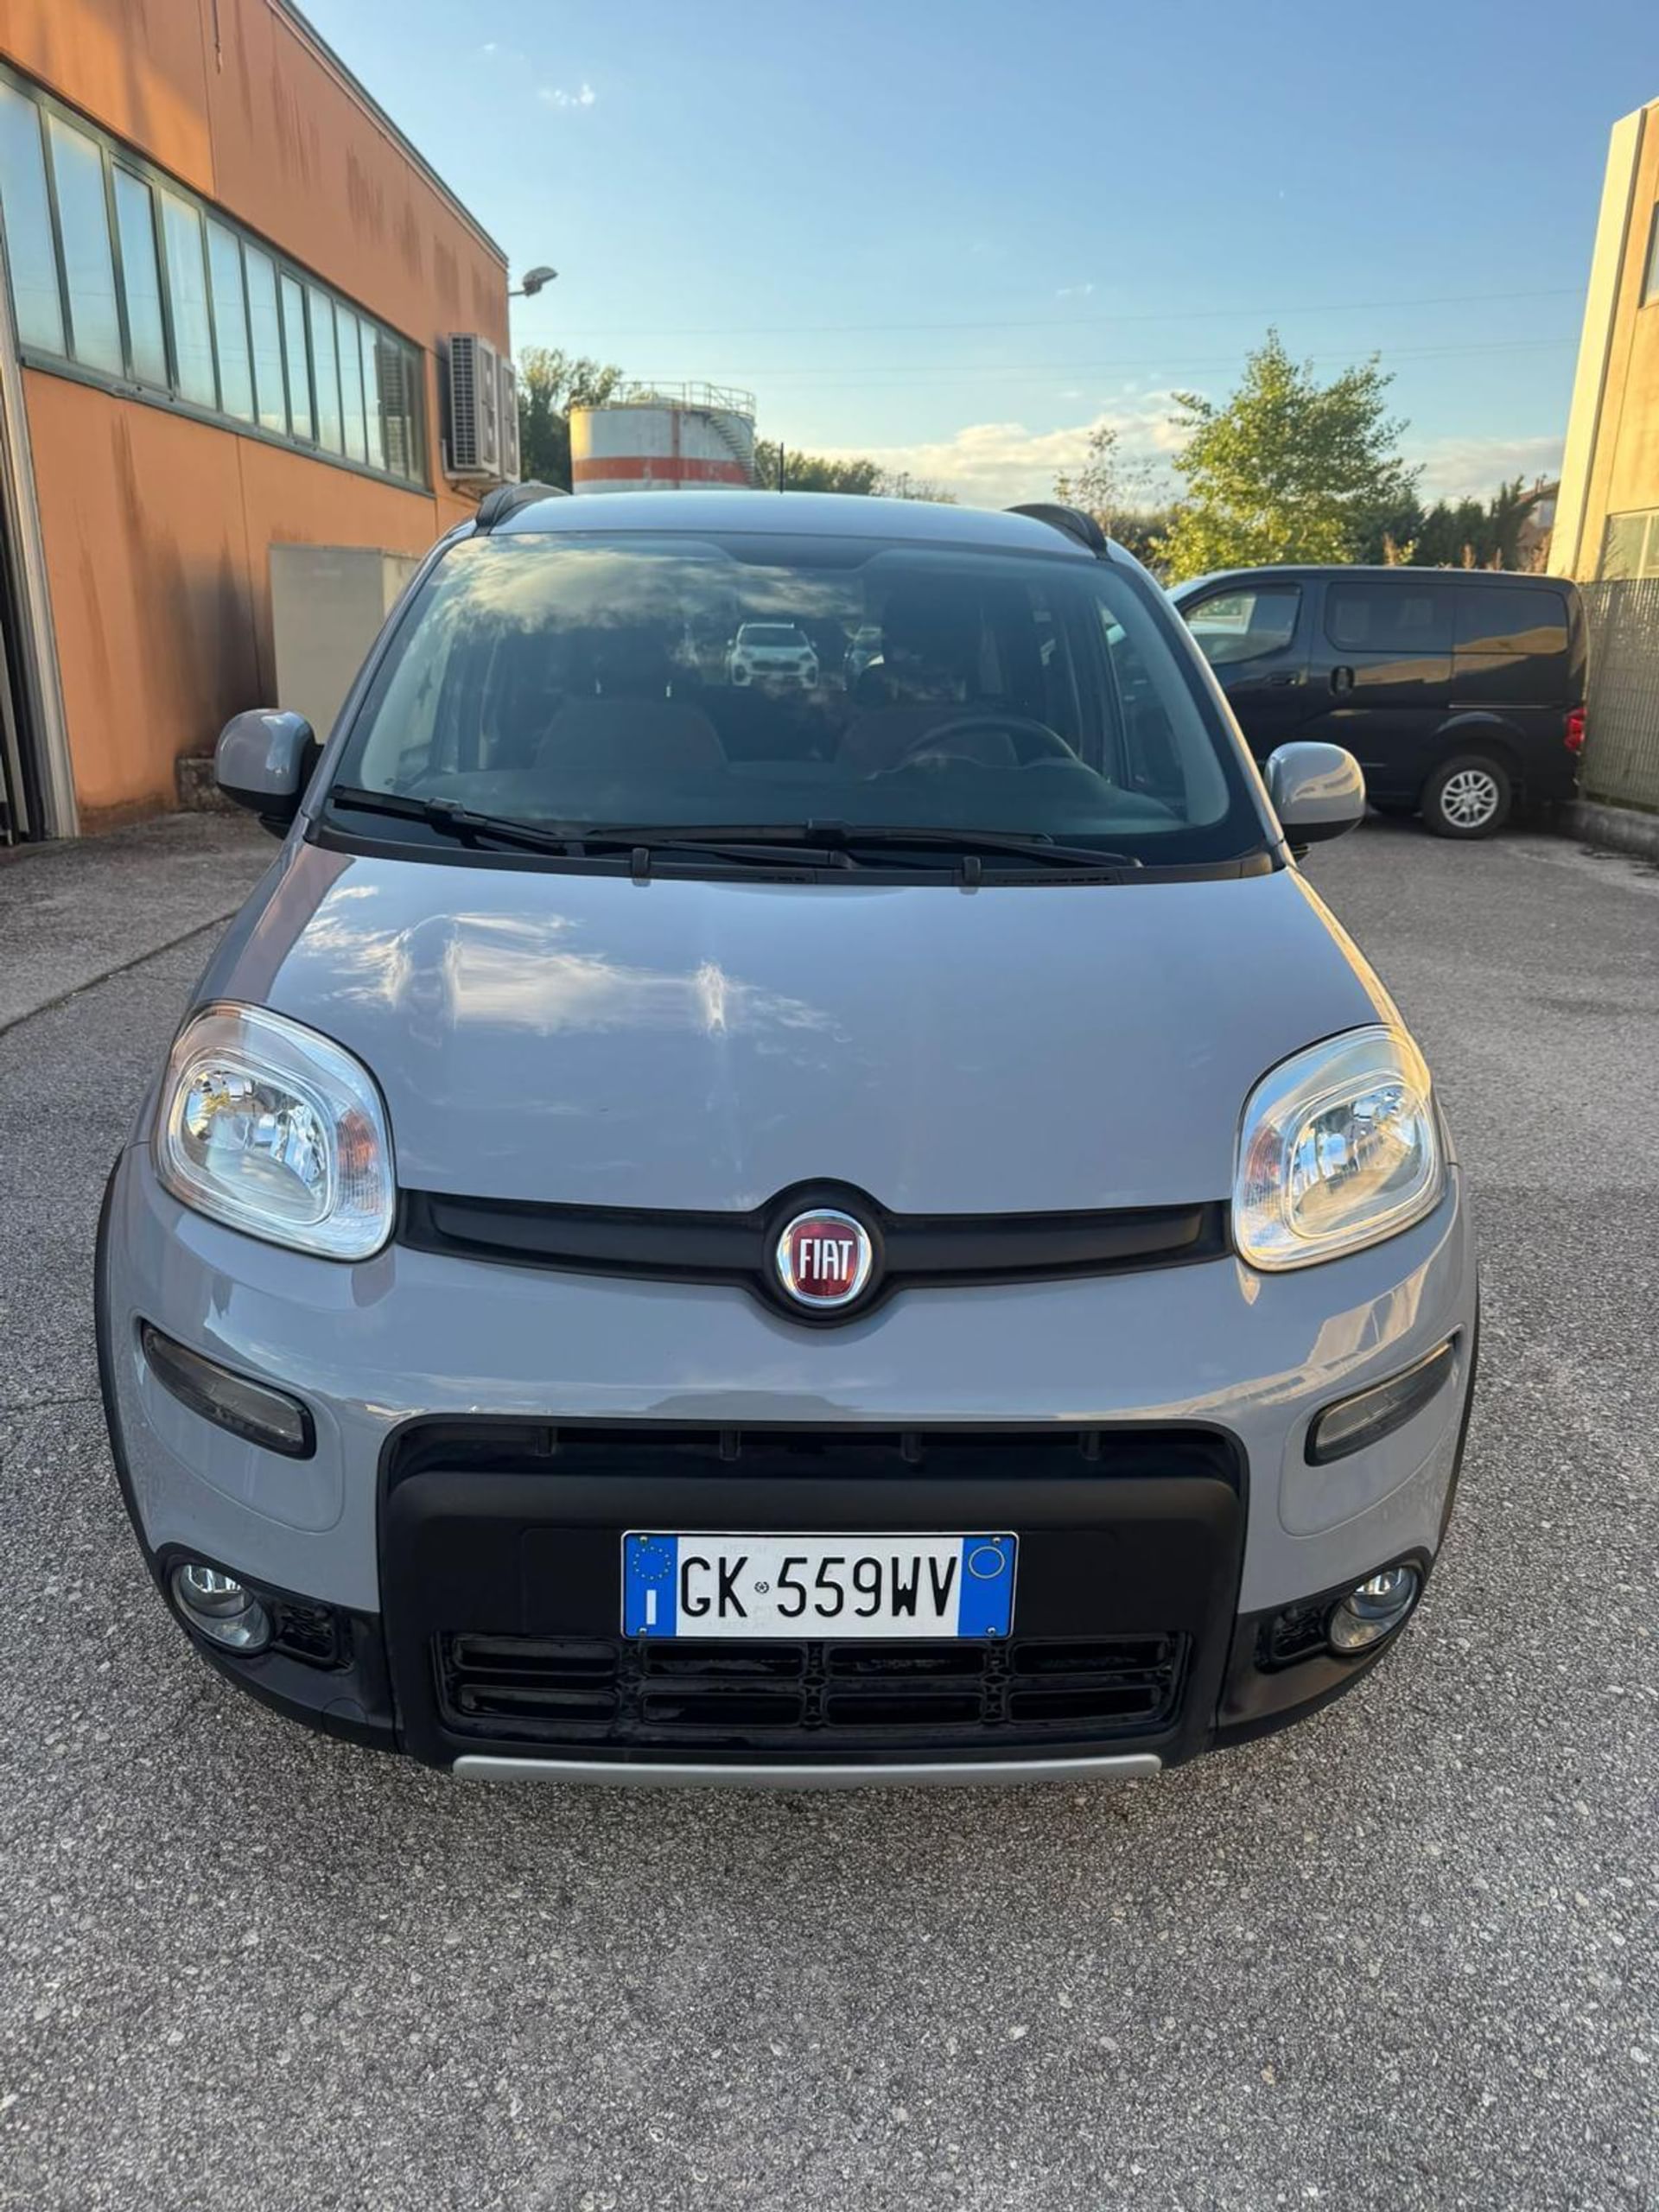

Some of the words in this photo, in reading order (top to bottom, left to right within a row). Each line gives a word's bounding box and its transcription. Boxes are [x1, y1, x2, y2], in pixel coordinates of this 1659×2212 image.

[800, 1238, 853, 1280] FIAT
[646, 1590, 657, 1624] I
[681, 1556, 748, 1618] GK
[777, 1556, 957, 1618] 559WV
